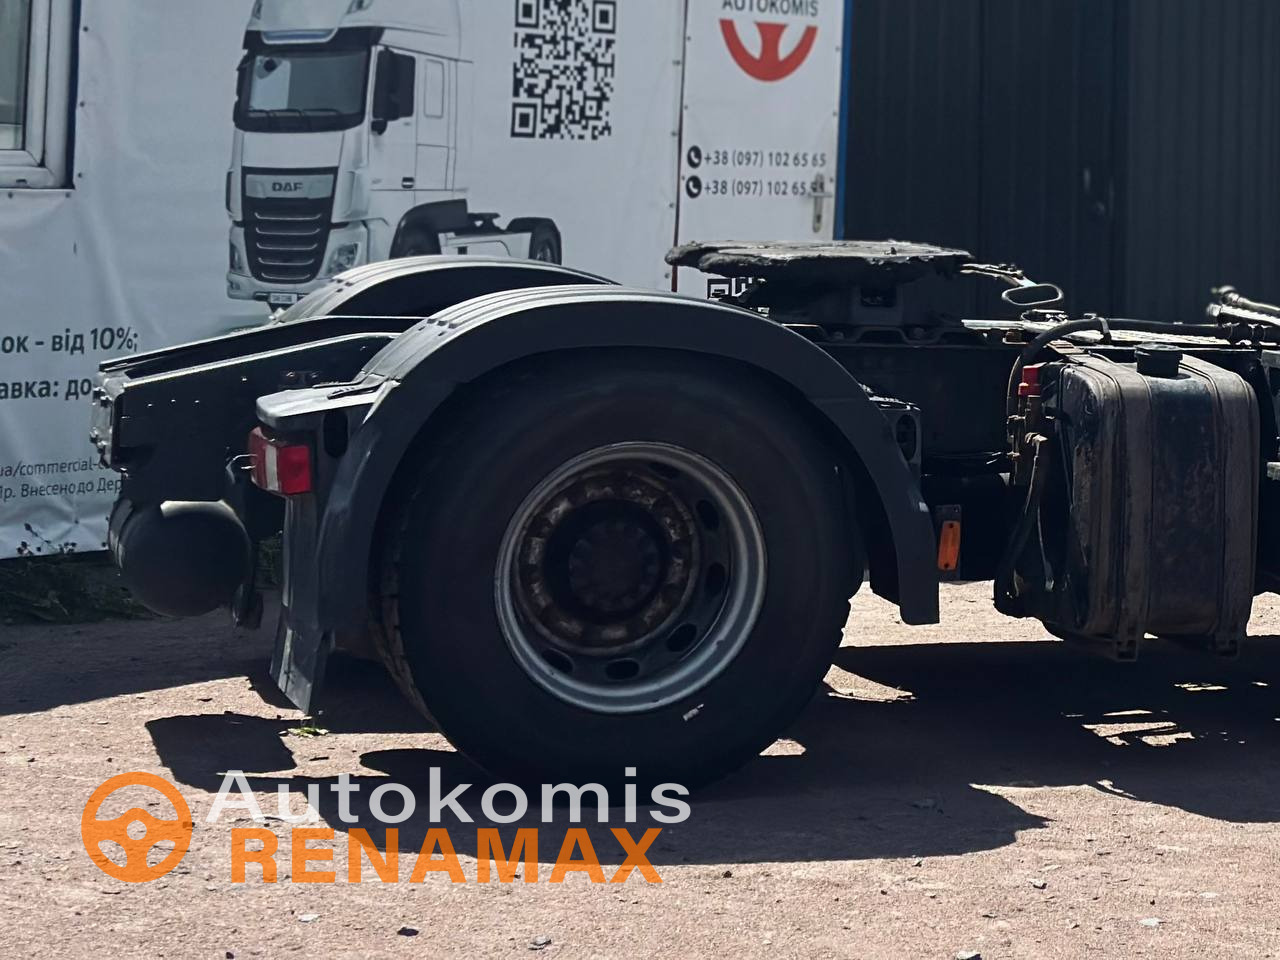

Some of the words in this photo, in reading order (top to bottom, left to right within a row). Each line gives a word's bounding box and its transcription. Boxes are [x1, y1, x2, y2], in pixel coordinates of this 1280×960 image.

[704, 150, 729, 166] +38
[732, 150, 764, 168] (097)
[768, 152, 789, 167] 102
[793, 153, 808, 167] 65
[811, 153, 826, 167] 65
[271, 182, 304, 192] DAF
[704, 180, 728, 195] +38
[732, 180, 763, 197] (097)
[767, 181, 788, 196] 102
[792, 181, 807, 196] 65
[51, 328, 85, 355] від
[90, 326, 138, 352] 10%;
[21, 482, 75, 498] Внесено
[77, 480, 94, 494] до
